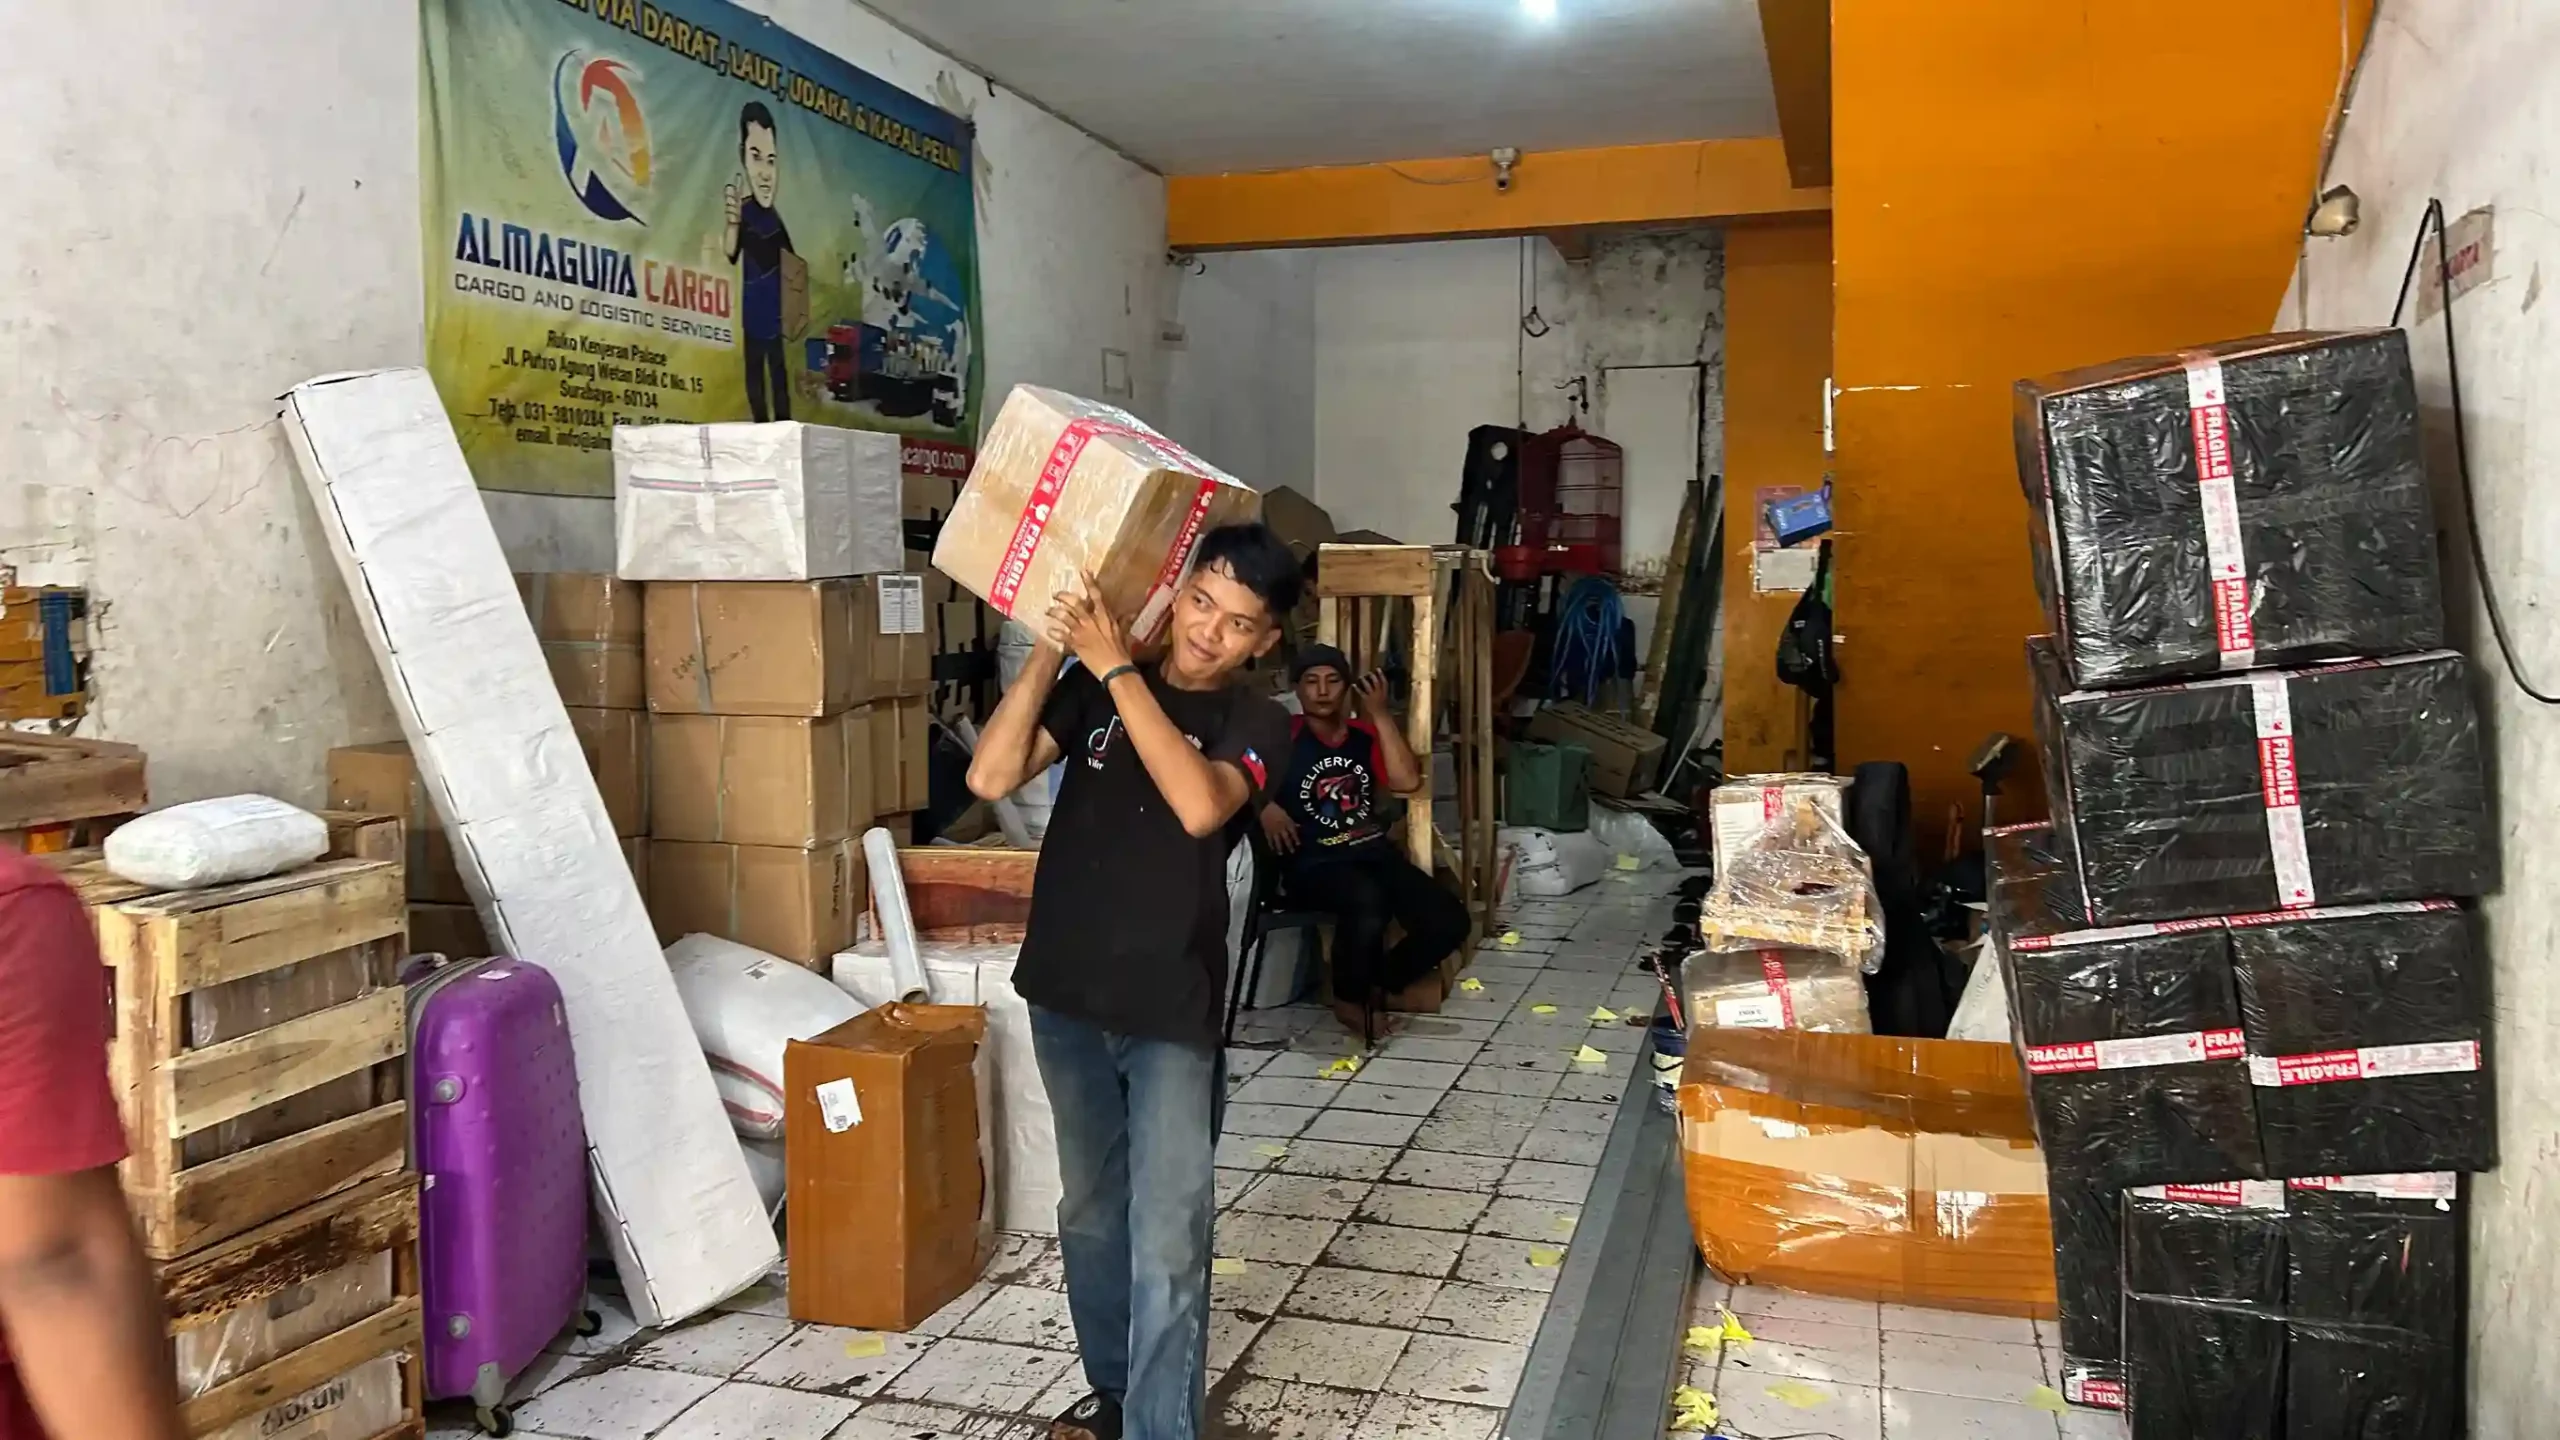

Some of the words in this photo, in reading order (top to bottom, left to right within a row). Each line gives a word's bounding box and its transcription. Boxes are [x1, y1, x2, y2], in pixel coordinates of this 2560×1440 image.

[789, 67, 852, 126] UDARA
[855, 104, 868, 133] &
[869, 108, 920, 154] KAPAL
[455, 212, 638, 298] ALMAGUNA
[644, 260, 731, 318] CARGO
[454, 273, 526, 302] CARGO
[533, 289, 574, 312] AND
[580, 299, 655, 328] LOGISTIC
[661, 316, 732, 343] SERVICES
[560, 379, 614, 406] Surabaya
[660, 372, 668, 388] C
[690, 376, 703, 393] 15
[901, 446, 966, 474] cargo.com
[2205, 406, 2229, 476] FRAGILE
[1002, 524, 1042, 602] FRAGILE
[2226, 579, 2250, 649] FRAGILE
[1300, 757, 1353, 799] DELIVERY
[2273, 737, 2296, 806] FRAGILE
[2028, 1045, 2094, 1063] FRAGILE
[2282, 1061, 2359, 1082] FRAGILE
